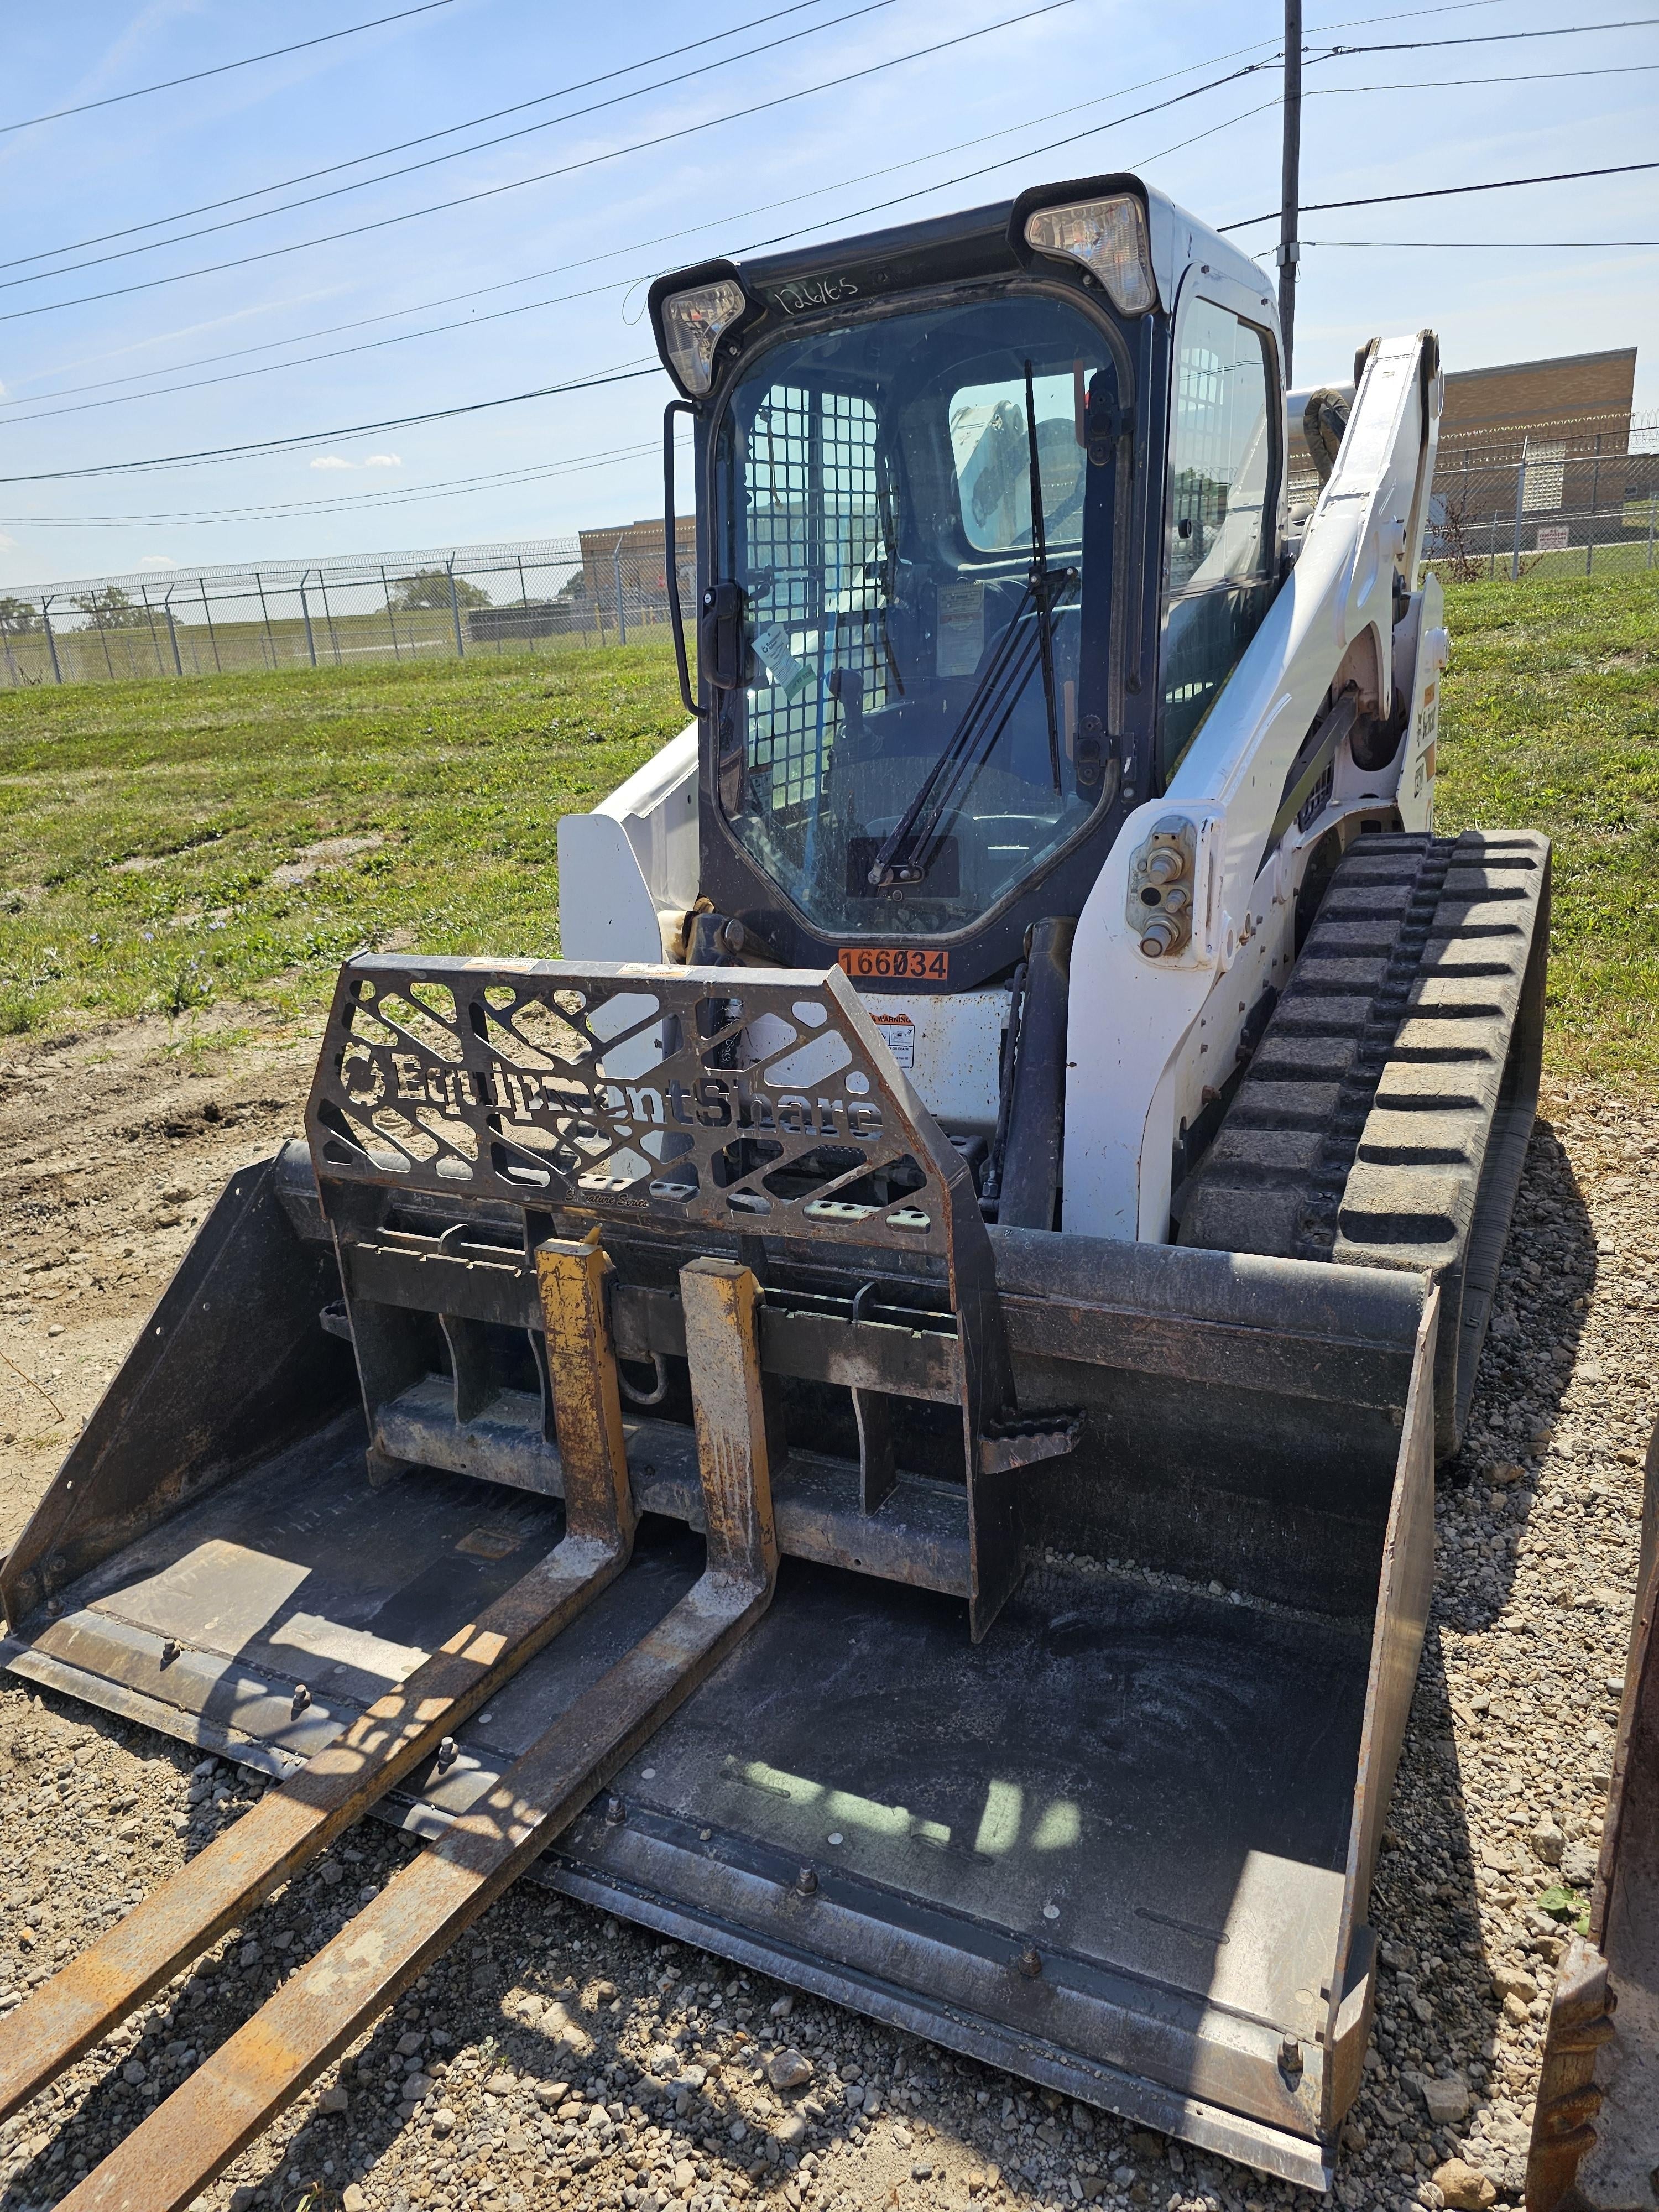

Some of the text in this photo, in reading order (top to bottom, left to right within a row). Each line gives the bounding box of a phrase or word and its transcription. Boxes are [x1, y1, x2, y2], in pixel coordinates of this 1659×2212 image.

[841, 951, 946, 978] 166034
[391, 1053, 884, 1141] EquipmentShare
[616, 1193, 649, 1208] Series
